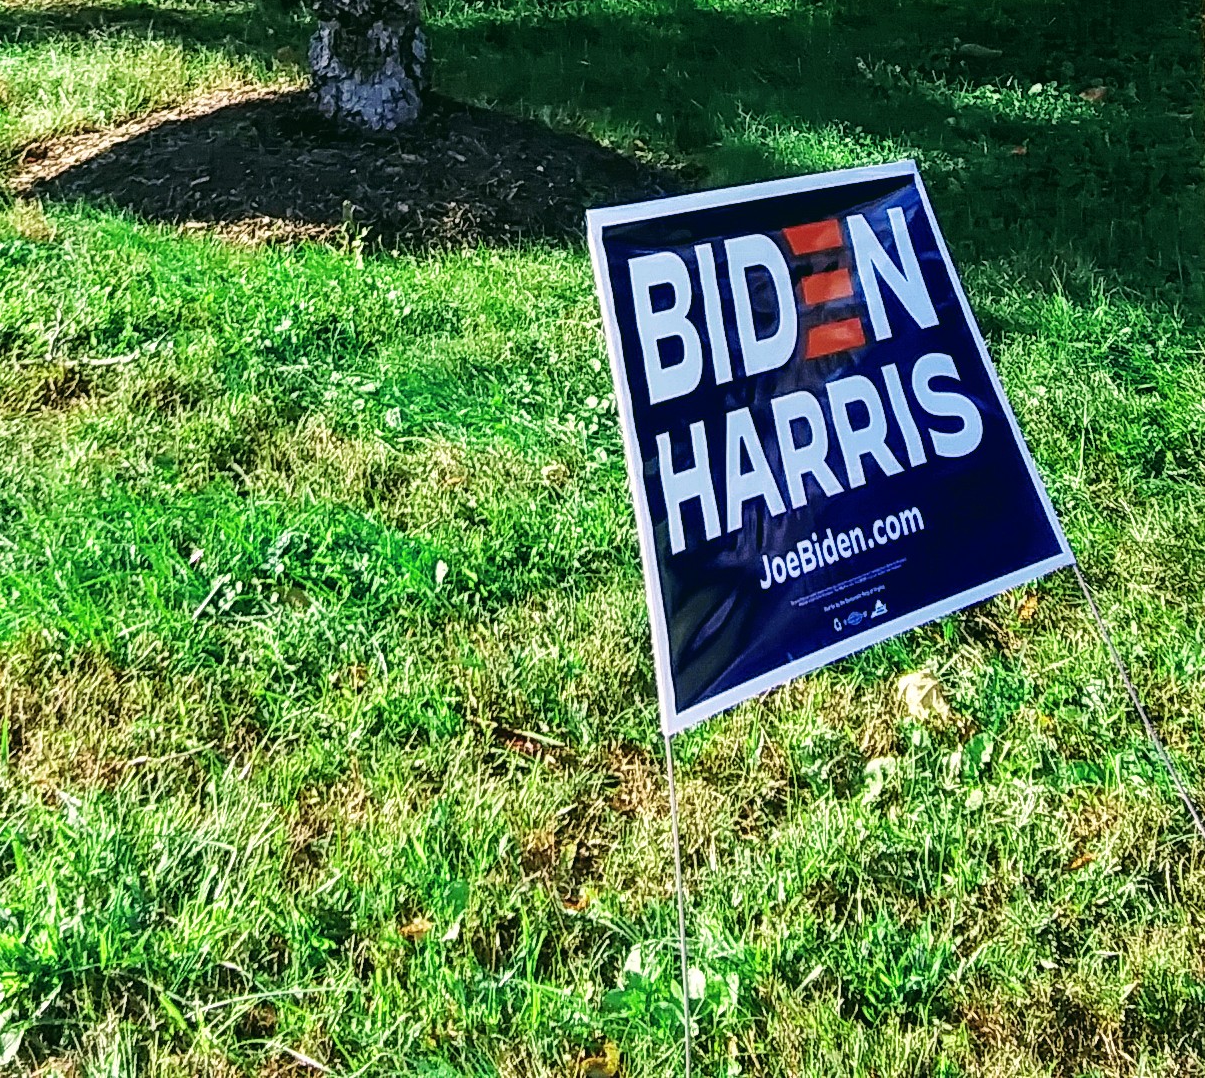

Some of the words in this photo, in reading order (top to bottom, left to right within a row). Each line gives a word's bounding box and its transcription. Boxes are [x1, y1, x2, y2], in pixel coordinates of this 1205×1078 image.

[628, 206, 940, 406] BIDEN
[656, 352, 984, 556] HARRIS
[760, 506, 925, 590] JoeBiden.com
